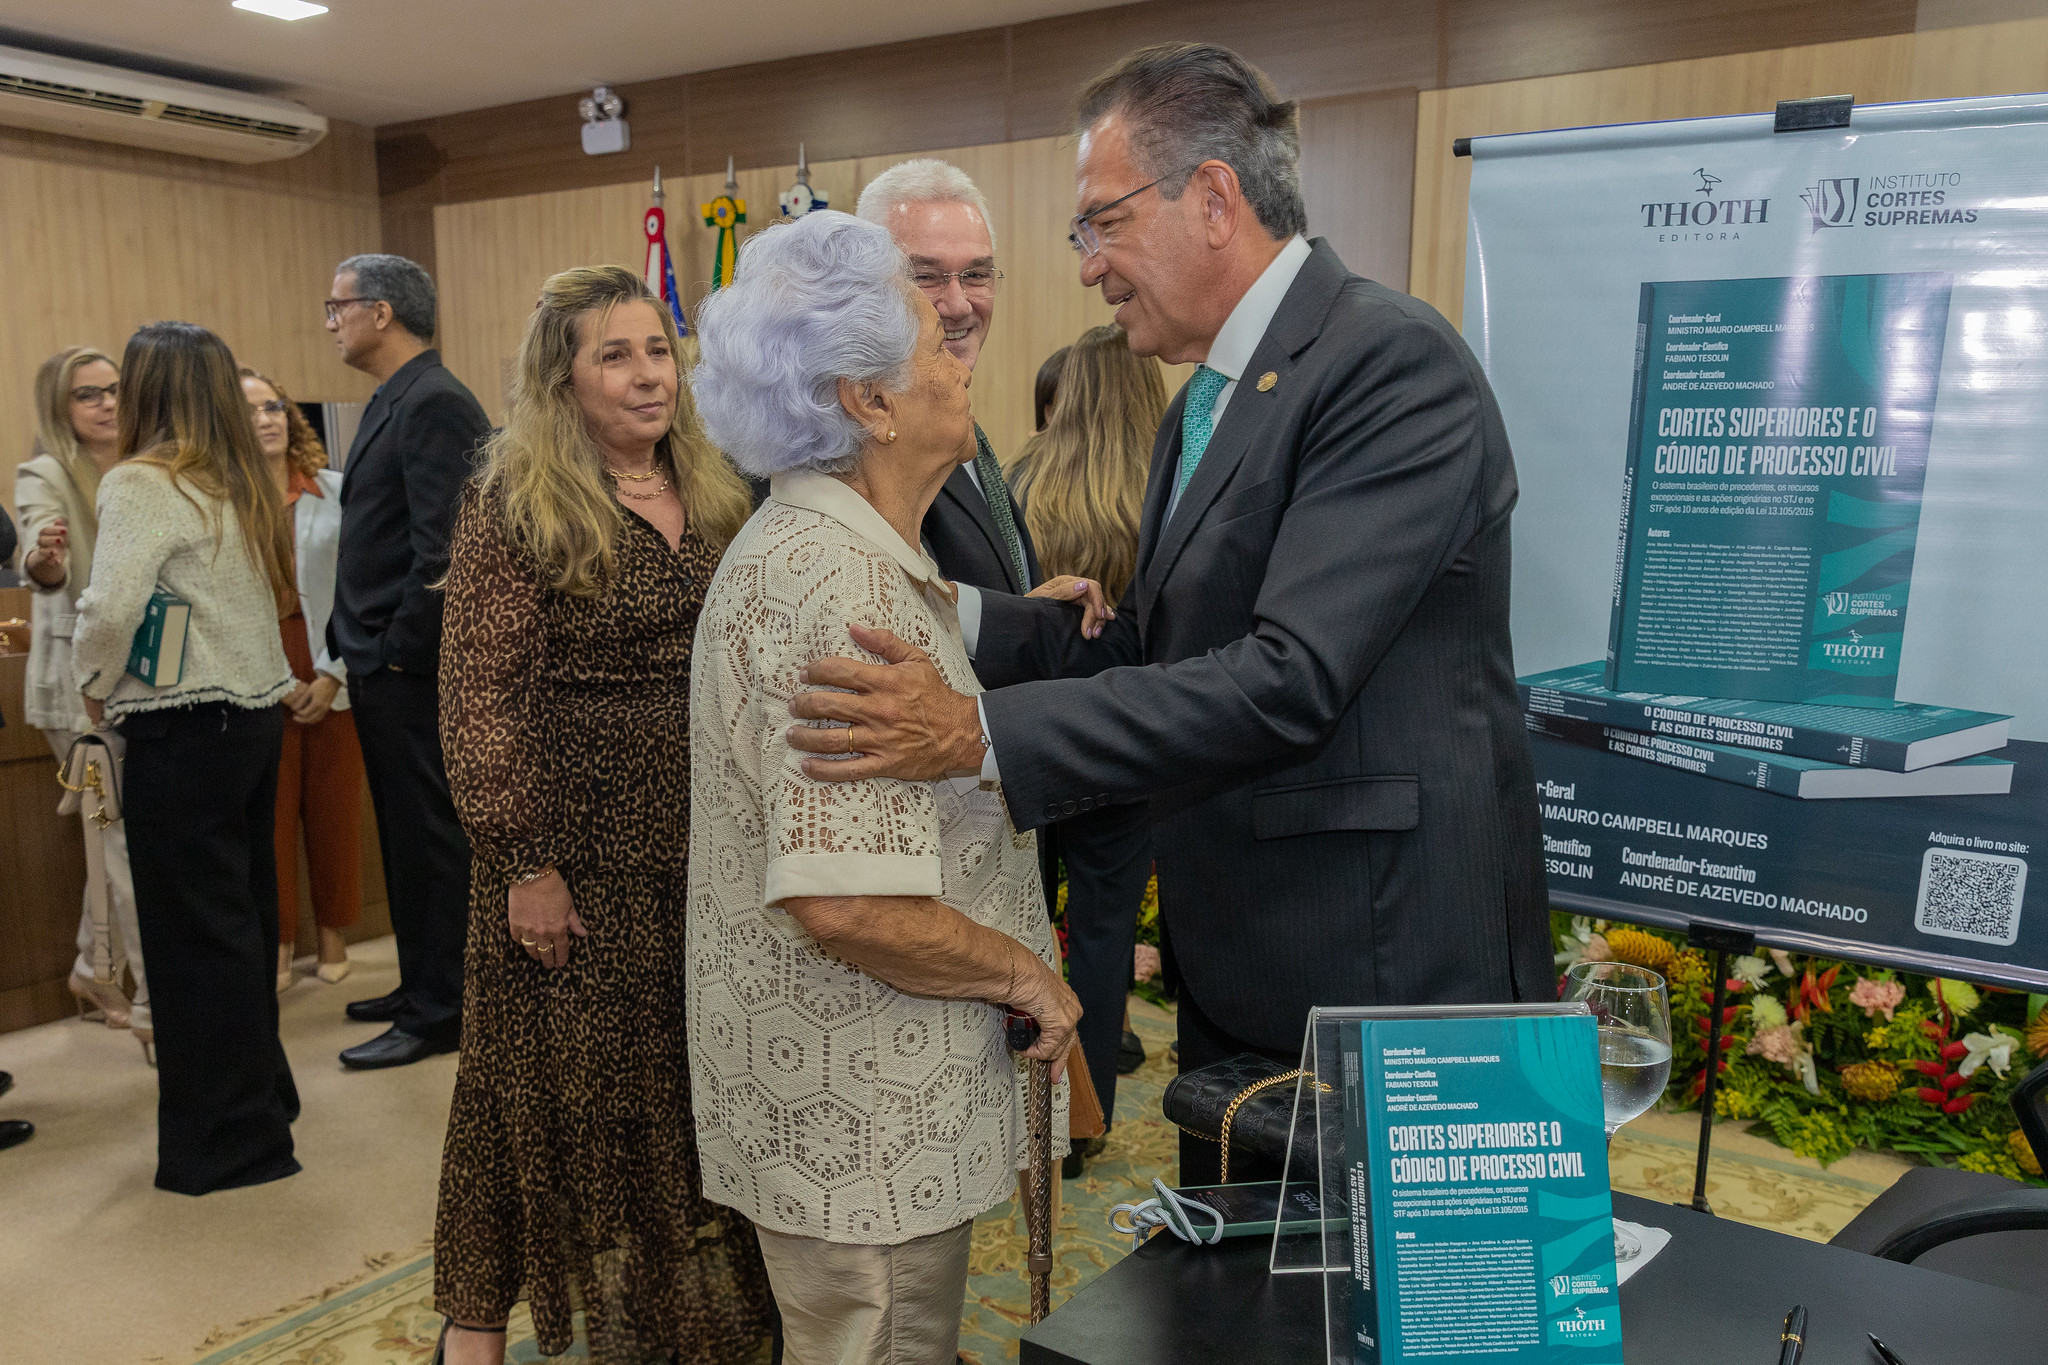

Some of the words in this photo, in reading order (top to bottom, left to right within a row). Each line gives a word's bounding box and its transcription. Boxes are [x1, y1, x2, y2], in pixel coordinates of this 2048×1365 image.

[1869, 172, 1961, 189] INSTITUTO
[1866, 190, 1945, 208] CORTES
[1641, 199, 1771, 228] THOTH
[1864, 208, 1978, 227] SUPREMAS
[1659, 232, 1740, 242] EDITORA
[1668, 313, 1721, 324] Coordenador-Geral
[1668, 326, 1704, 335] MINISTRO
[1705, 325, 1732, 334] MAURO
[1733, 324, 1774, 333] CAMPBELL
[1665, 342, 1729, 352] Coordenador-Científico
[1665, 354, 1697, 363] FABIANO
[1698, 354, 1729, 362] TESOLIN
[1663, 370, 1725, 380] Coordenador-Executivo
[1662, 381, 1688, 391] ANDRÉ
[1688, 382, 1700, 391] DE
[1700, 382, 1735, 390] AZEVEDO
[1735, 381, 1775, 390] MACHADO
[1658, 407, 1726, 437] CORTES
[1728, 407, 1845, 437] SUPERIORES
[1846, 407, 1860, 437] E
[1862, 407, 1877, 437] O
[1654, 441, 1721, 475] CÓDIGO
[1723, 445, 1747, 475] DE
[1749, 445, 1848, 476] PROCESSO
[1850, 446, 1898, 476] CIVIL
[1652, 481, 1659, 490] O
[1659, 481, 1686, 490] sistema
[1686, 481, 1719, 491] brasileiro
[1719, 482, 1729, 491] de
[1729, 482, 1776, 492] precedentes,
[1787, 484, 1820, 492] recursos
[1650, 493, 1695, 503] excepcionais
[1711, 493, 1733, 504] ações
[1733, 494, 1772, 505] originárias
[1772, 496, 1782, 504] no
[1782, 495, 1798, 504] STJ
[1804, 496, 1815, 504] no
[1649, 504, 1664, 513] STF
[1664, 505, 1681, 514] após
[1682, 505, 1691, 514] 10
[1691, 506, 1709, 514] anos
[1709, 505, 1719, 514] de
[1720, 506, 1744, 516] edição
[1745, 506, 1755, 515] da
[1755, 506, 1767, 515] Lei
[1767, 507, 1814, 516] 13.105/2015
[1647, 527, 1671, 538] Autores
[1852, 593, 1891, 601] INSTITUTO
[1851, 600, 1885, 609] CORTES
[1850, 607, 1898, 617] SUPREMAS
[1823, 643, 1886, 659] THOTH
[1644, 706, 1652, 717] O
[1653, 707, 1691, 723] CÓDIGO
[1693, 714, 1707, 726] DE
[1708, 716, 1765, 735] PROCESSO
[1766, 723, 1794, 739] CIVIL
[1651, 720, 1658, 731] E
[1659, 720, 1673, 733] AS
[1674, 723, 1714, 740] CORTES
[1715, 730, 1784, 751] SUPERIORES
[1603, 727, 1610, 737] O
[1610, 728, 1639, 744] CÓDIGO
[1639, 735, 1650, 746] DE
[1651, 737, 1693, 757] PROCESSO
[1693, 748, 1715, 763] CIVIL
[1849, 736, 1863, 765] THOTH
[1608, 740, 1615, 750] E
[1614, 741, 1626, 753] AS
[1625, 744, 1656, 761] CORTES
[1656, 751, 1707, 774] SUPERIORES
[1756, 761, 1768, 788] THOTH
[1544, 804, 1600, 825] MAURO
[1601, 812, 1685, 839] CAMPBELL
[1686, 825, 1768, 850] MARQUES
[1928, 831, 1965, 846] Adquira
[1965, 837, 1973, 847] o
[1973, 836, 1994, 850] livro
[1994, 841, 2008, 851] no
[2008, 841, 2030, 854] site:
[1622, 847, 1757, 884] Coordenador-Executivo
[1619, 871, 1674, 894] ANDRÉ
[1676, 879, 1699, 897] DE
[1699, 884, 1778, 910] AZEVEDO
[1780, 896, 1868, 924] MACHADO
[1383, 1047, 1426, 1056] Coordenador-Geral
[1414, 1057, 1436, 1065] MAURO
[1437, 1056, 1469, 1064] CAMPBELL
[1469, 1055, 1500, 1063] MARQUES
[1384, 1070, 1436, 1079] Coordenador-Científico
[1412, 1080, 1439, 1088] TESOLIN
[1386, 1093, 1438, 1102] Coordenador-Executivo
[1387, 1103, 1408, 1112] ANDRÉ
[1418, 1103, 1447, 1111] AZEVEDO
[1447, 1102, 1478, 1110] MACHADO
[1388, 1124, 1445, 1152] CORTES
[1447, 1122, 1537, 1150] SUPERIORES
[1539, 1121, 1549, 1147] E
[1550, 1121, 1562, 1147] O
[1357, 1161, 1364, 1169] O
[1390, 1154, 1446, 1184] CÓDIGO
[1449, 1156, 1468, 1182] DE
[1469, 1153, 1547, 1181] PROCESSO
[1548, 1152, 1586, 1178] CIVIL
[1350, 1174, 1357, 1187] AS
[1357, 1170, 1365, 1205] CÓDIGO
[1392, 1189, 1398, 1197] O
[1398, 1189, 1422, 1197] sistema
[1422, 1187, 1449, 1196] brasileiro
[1449, 1187, 1457, 1195] de
[1458, 1186, 1495, 1196] precedentes,
[1351, 1189, 1359, 1223] CORTES
[1393, 1199, 1431, 1208] excepcionais
[1445, 1197, 1462, 1207] ações
[1463, 1196, 1493, 1206] originárias
[1502, 1195, 1513, 1204] STJ
[1359, 1205, 1367, 1218] DE
[1393, 1209, 1406, 1218] STF
[1406, 1209, 1421, 1218] após
[1422, 1208, 1430, 1216] 10
[1453, 1207, 1473, 1216] edição
[1474, 1206, 1482, 1215] da
[1482, 1206, 1491, 1214] Lei
[1492, 1205, 1529, 1214] 13.105/2015
[1395, 1230, 1416, 1240] Autores
[1360, 1219, 1369, 1267] PROCESSO
[1353, 1224, 1362, 1281] SUPERIORES
[1362, 1268, 1371, 1291] CIVIL
[1557, 1320, 1605, 1332] THOTH
